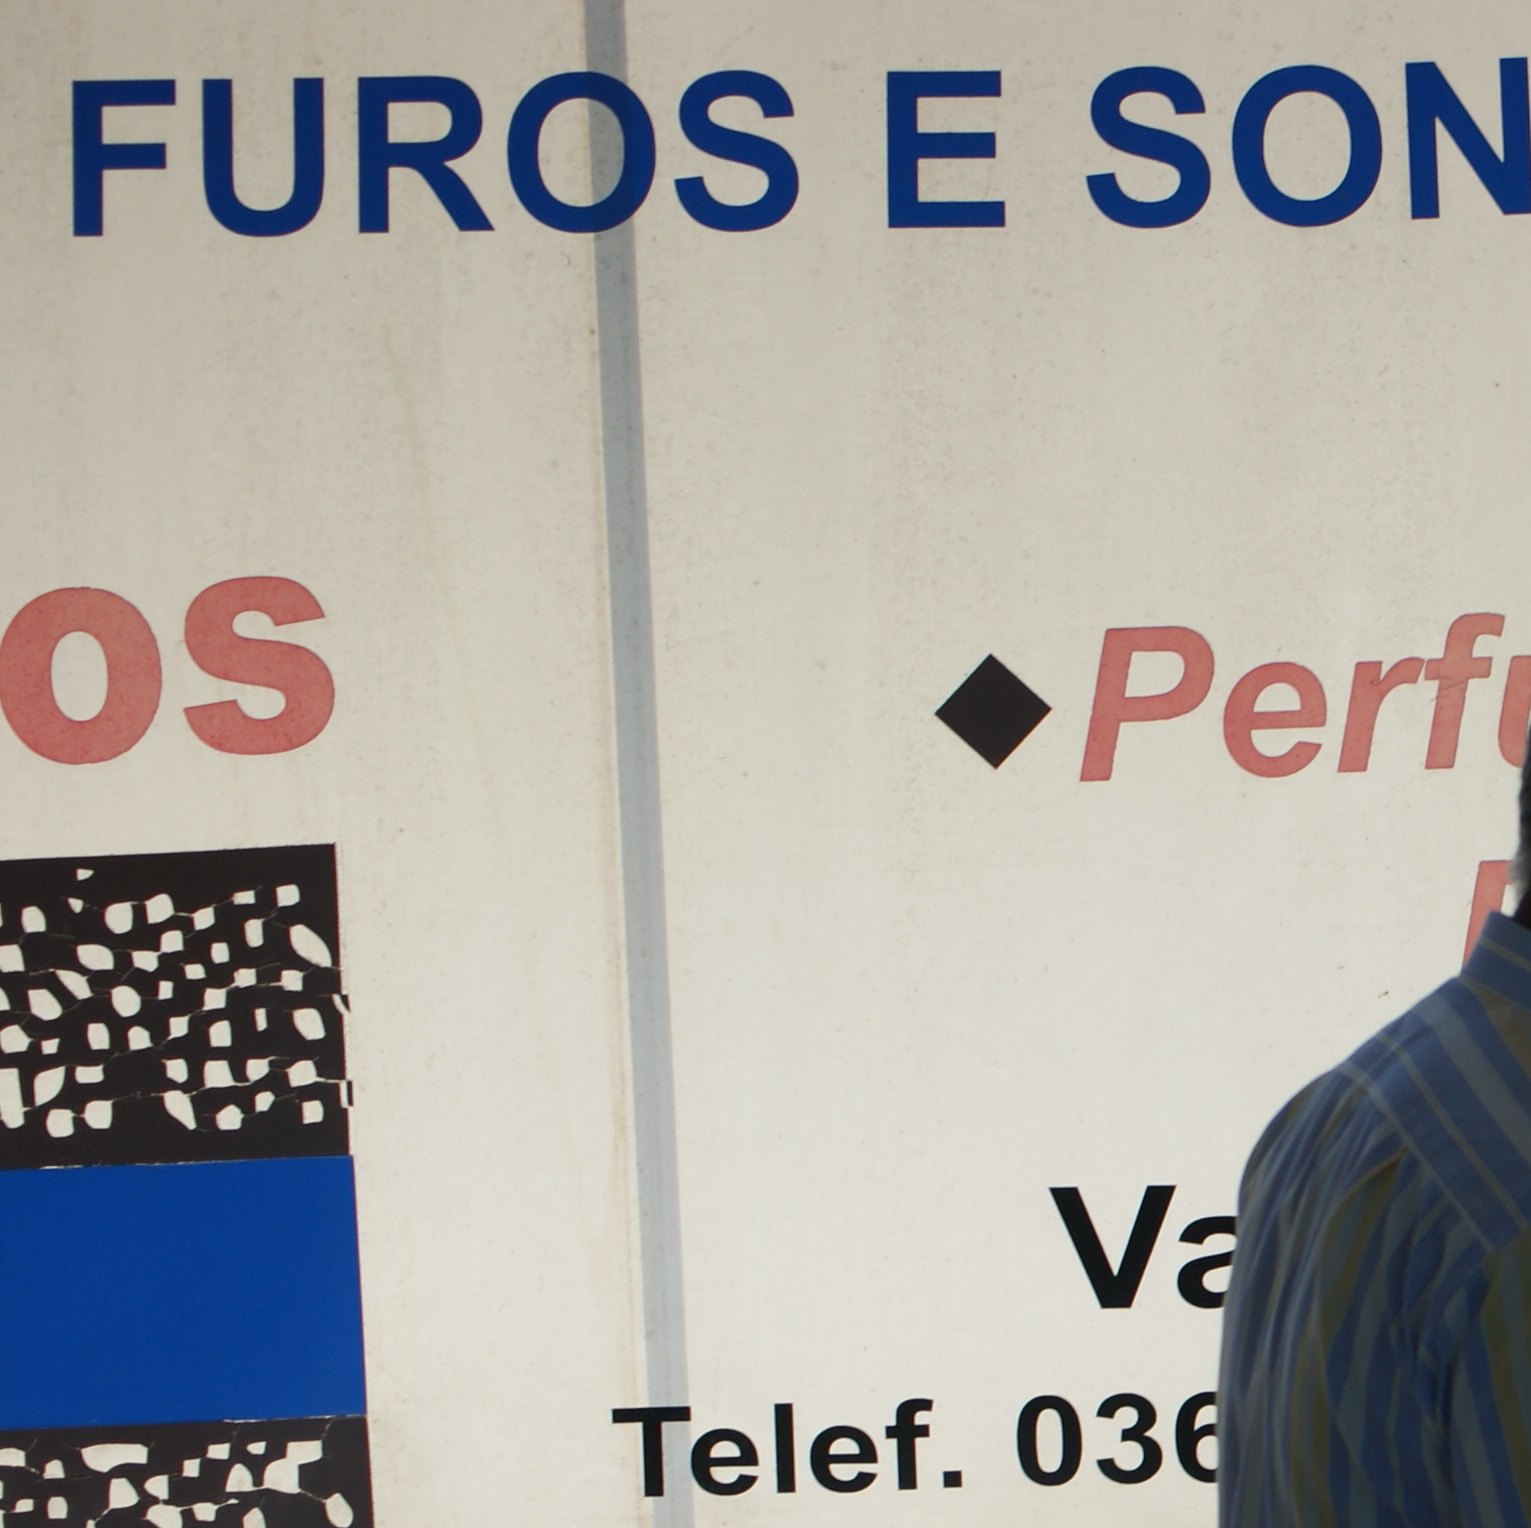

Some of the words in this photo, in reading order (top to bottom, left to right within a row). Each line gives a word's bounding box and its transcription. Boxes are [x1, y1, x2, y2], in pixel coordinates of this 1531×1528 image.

[72, 70, 800, 237] FUROS
[887, 70, 1006, 228] E
[611, 1397, 963, 1497] Telef.
